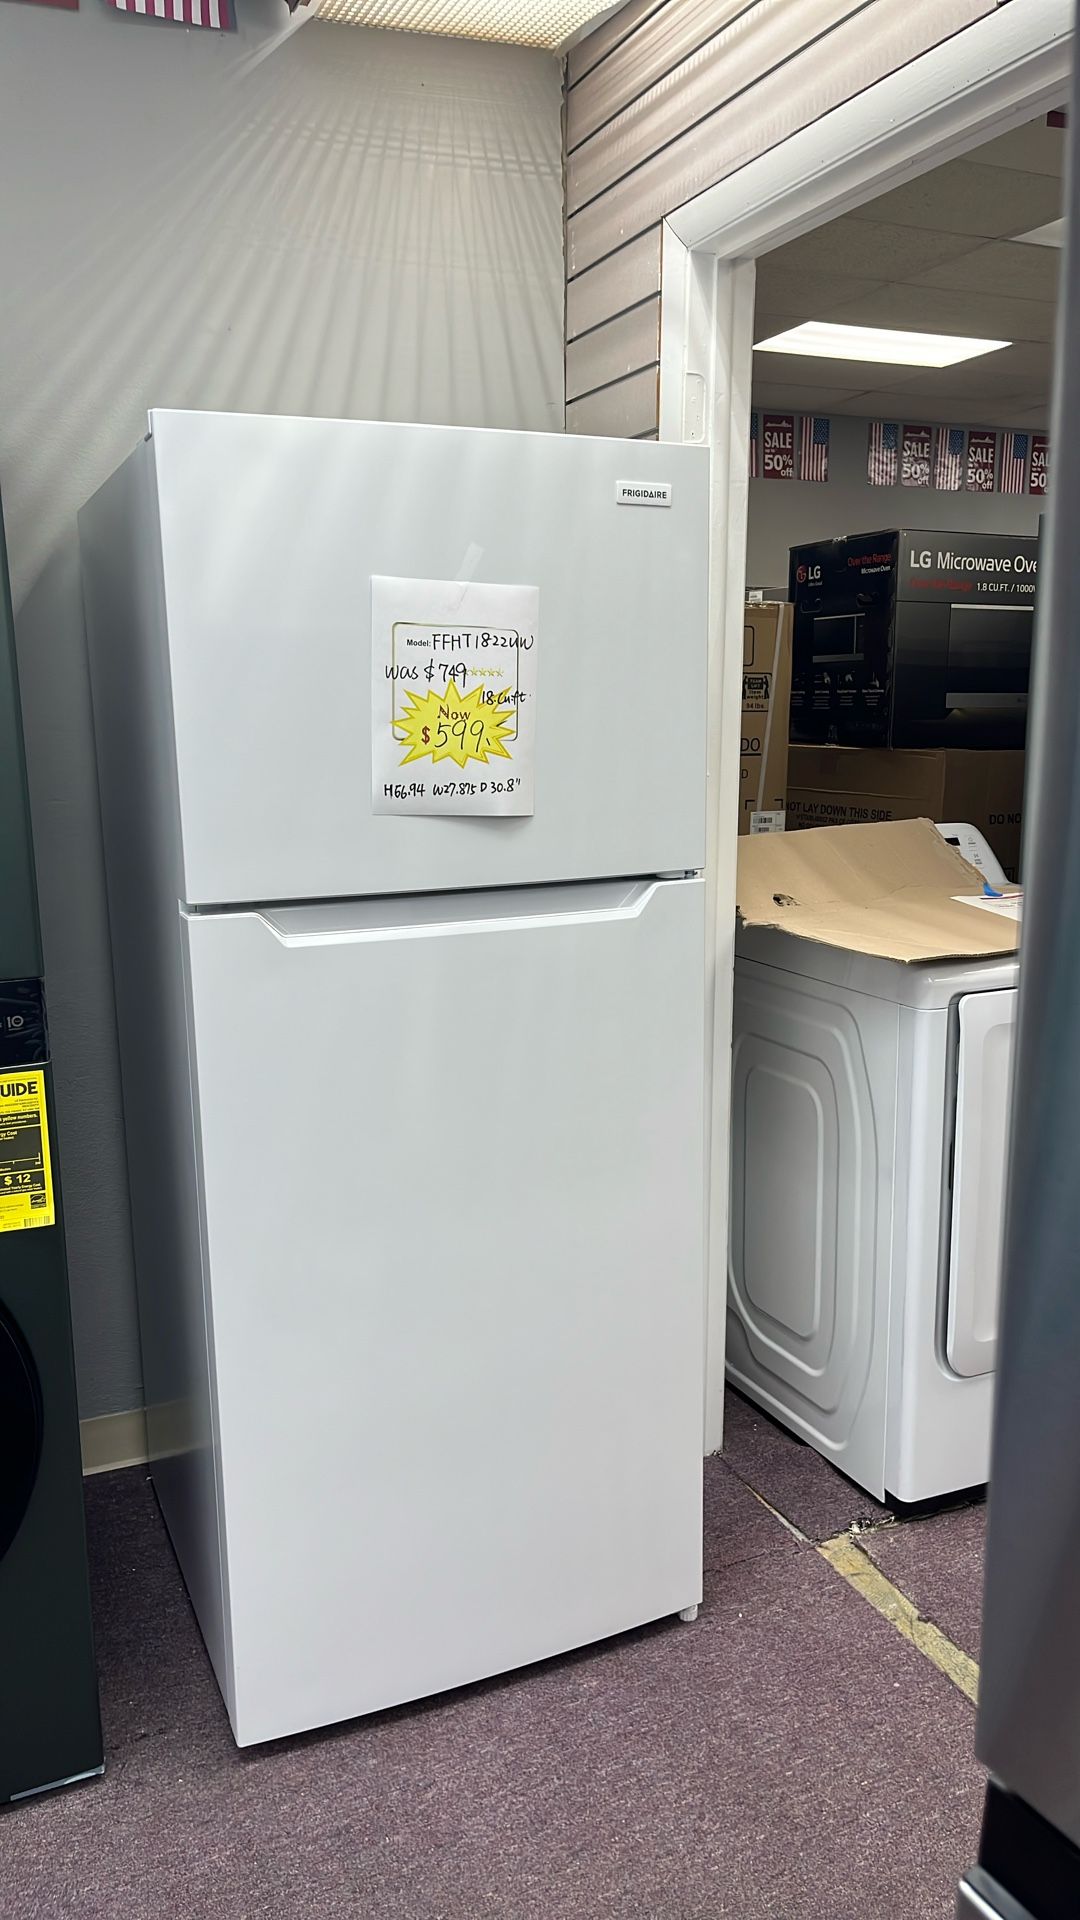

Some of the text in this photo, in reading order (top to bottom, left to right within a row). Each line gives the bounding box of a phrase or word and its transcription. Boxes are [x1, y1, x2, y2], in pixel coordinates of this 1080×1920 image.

[764, 431, 792, 449] SALE
[903, 440, 930, 458] SALE
[968, 446, 994, 464] SALE
[764, 454, 793, 471] 50%
[902, 462, 930, 478] 50%
[781, 467, 793, 477] off
[967, 468, 994, 484] 50%
[917, 476, 929, 485] off
[982, 480, 993, 490] off
[622, 488, 667, 499] FRIGIDAIRE
[910, 550, 932, 569] LG
[937, 551, 1012, 572] Microwave
[808, 565, 821, 580] LG
[976, 582, 988, 592] 1.8
[406, 638, 431, 647] Model:
[437, 704, 471, 720] Now
[803, 803, 819, 814] LAY
[820, 804, 848, 817] DOWN
[849, 807, 869, 819] THIS
[871, 808, 892, 821] SIDE
[989, 814, 1005, 825] DO
